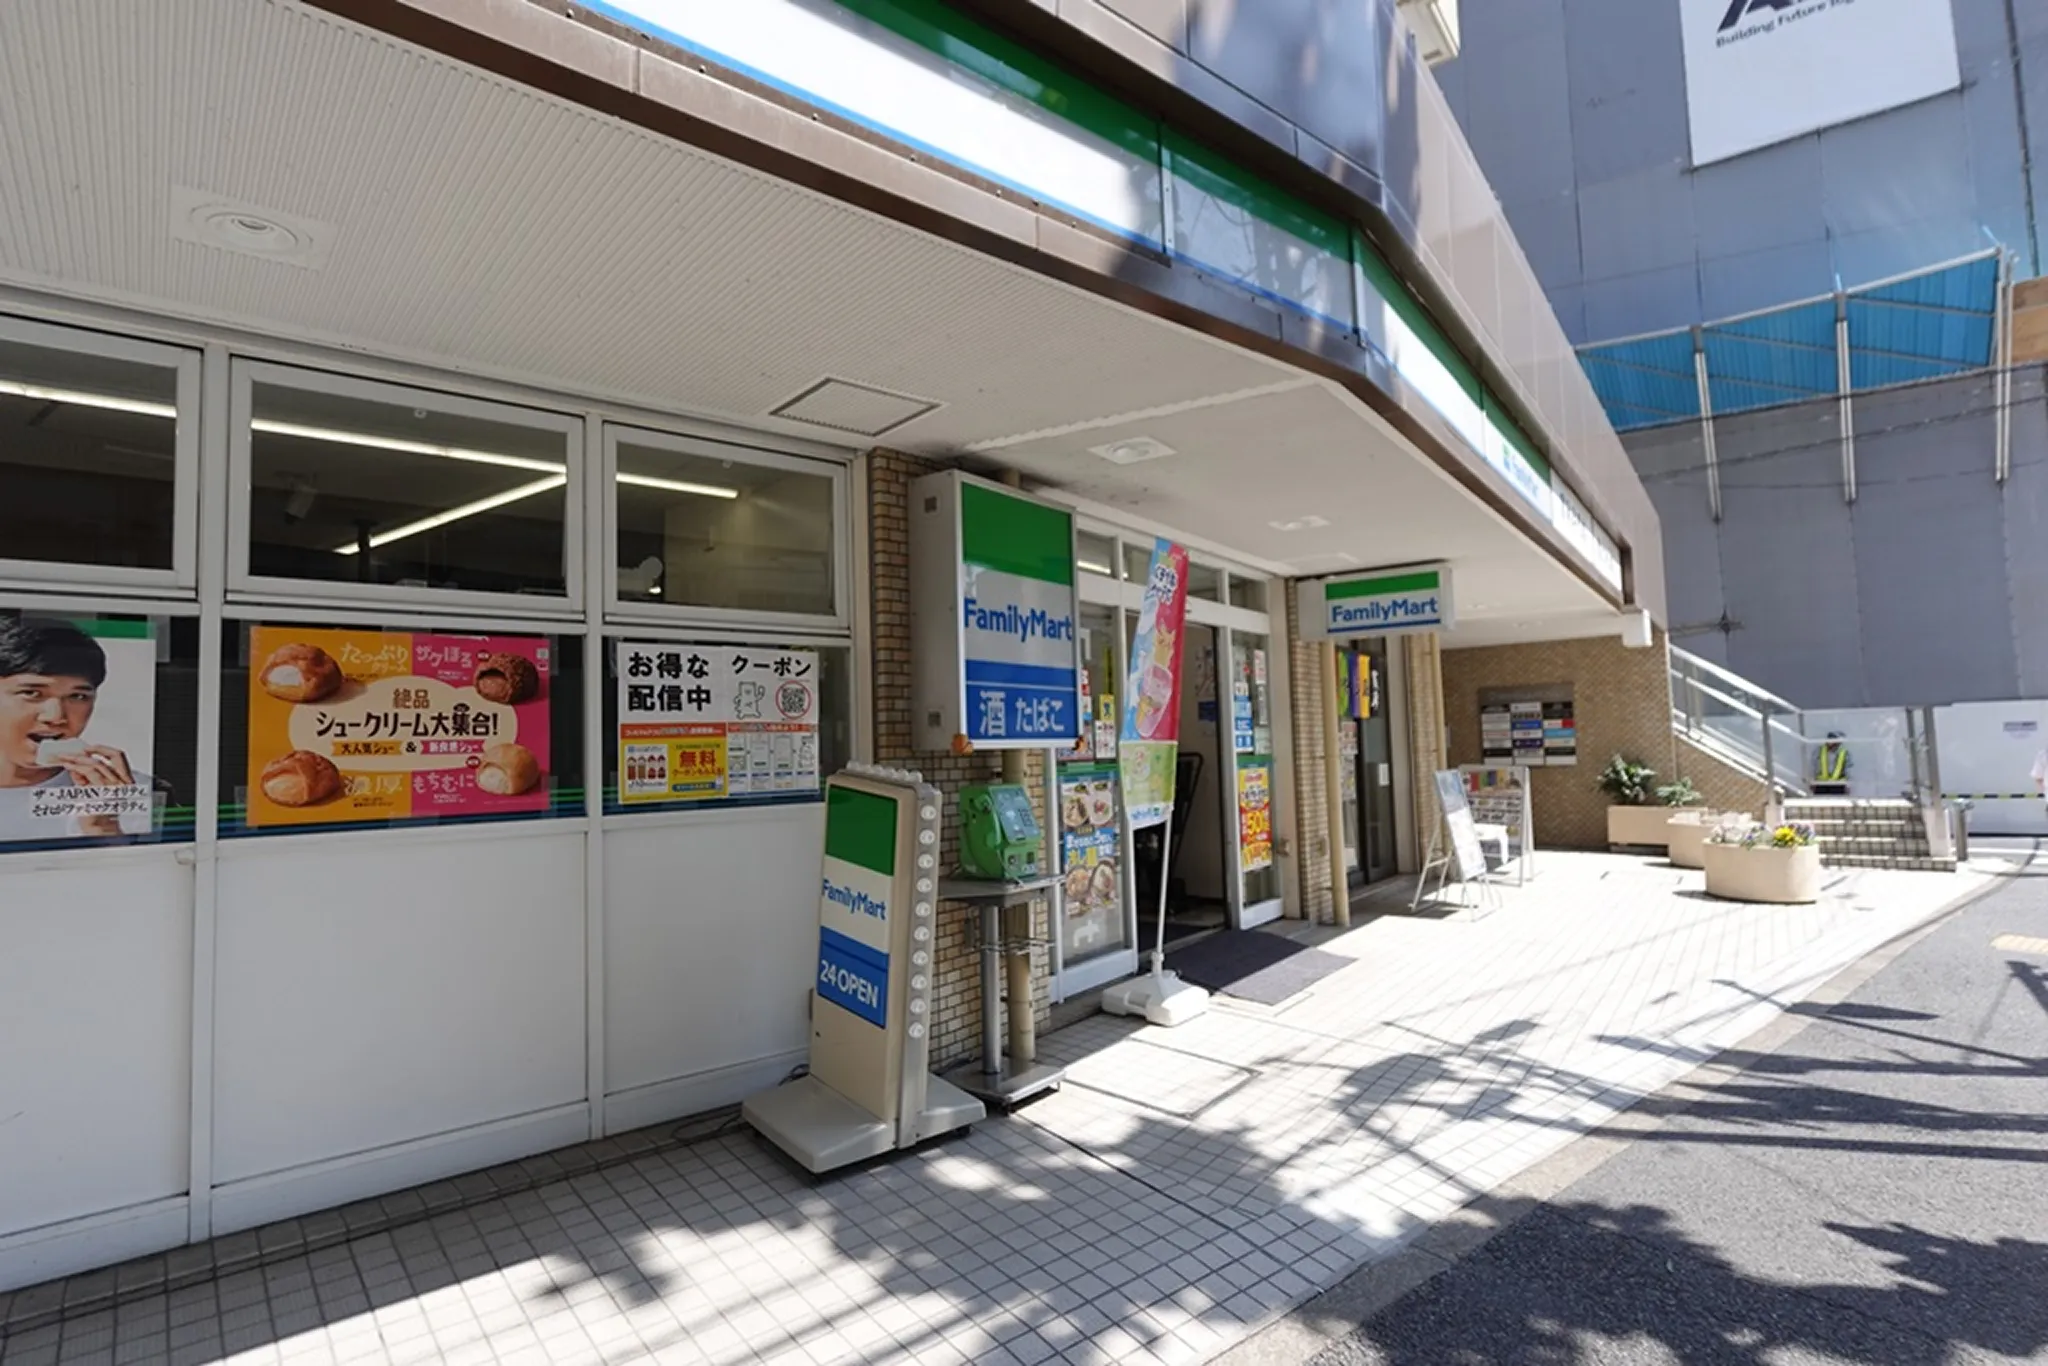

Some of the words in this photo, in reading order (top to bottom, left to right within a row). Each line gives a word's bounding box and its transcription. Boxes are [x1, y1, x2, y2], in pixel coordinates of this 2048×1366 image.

[1715, 20, 1775, 48] Building
[1777, 1, 1827, 26] Future
[963, 597, 1072, 643] FamilyMart
[1332, 597, 1439, 623] FamilyMart
[341, 642, 409, 664] たっぷり
[628, 651, 710, 679] お得な
[731, 654, 812, 678] クーポン
[392, 688, 430, 710] 絶品
[627, 683, 712, 712] 配信中
[979, 689, 1007, 737] 酒
[1015, 697, 1065, 733] たばこ
[821, 878, 887, 921] FamilyMart
